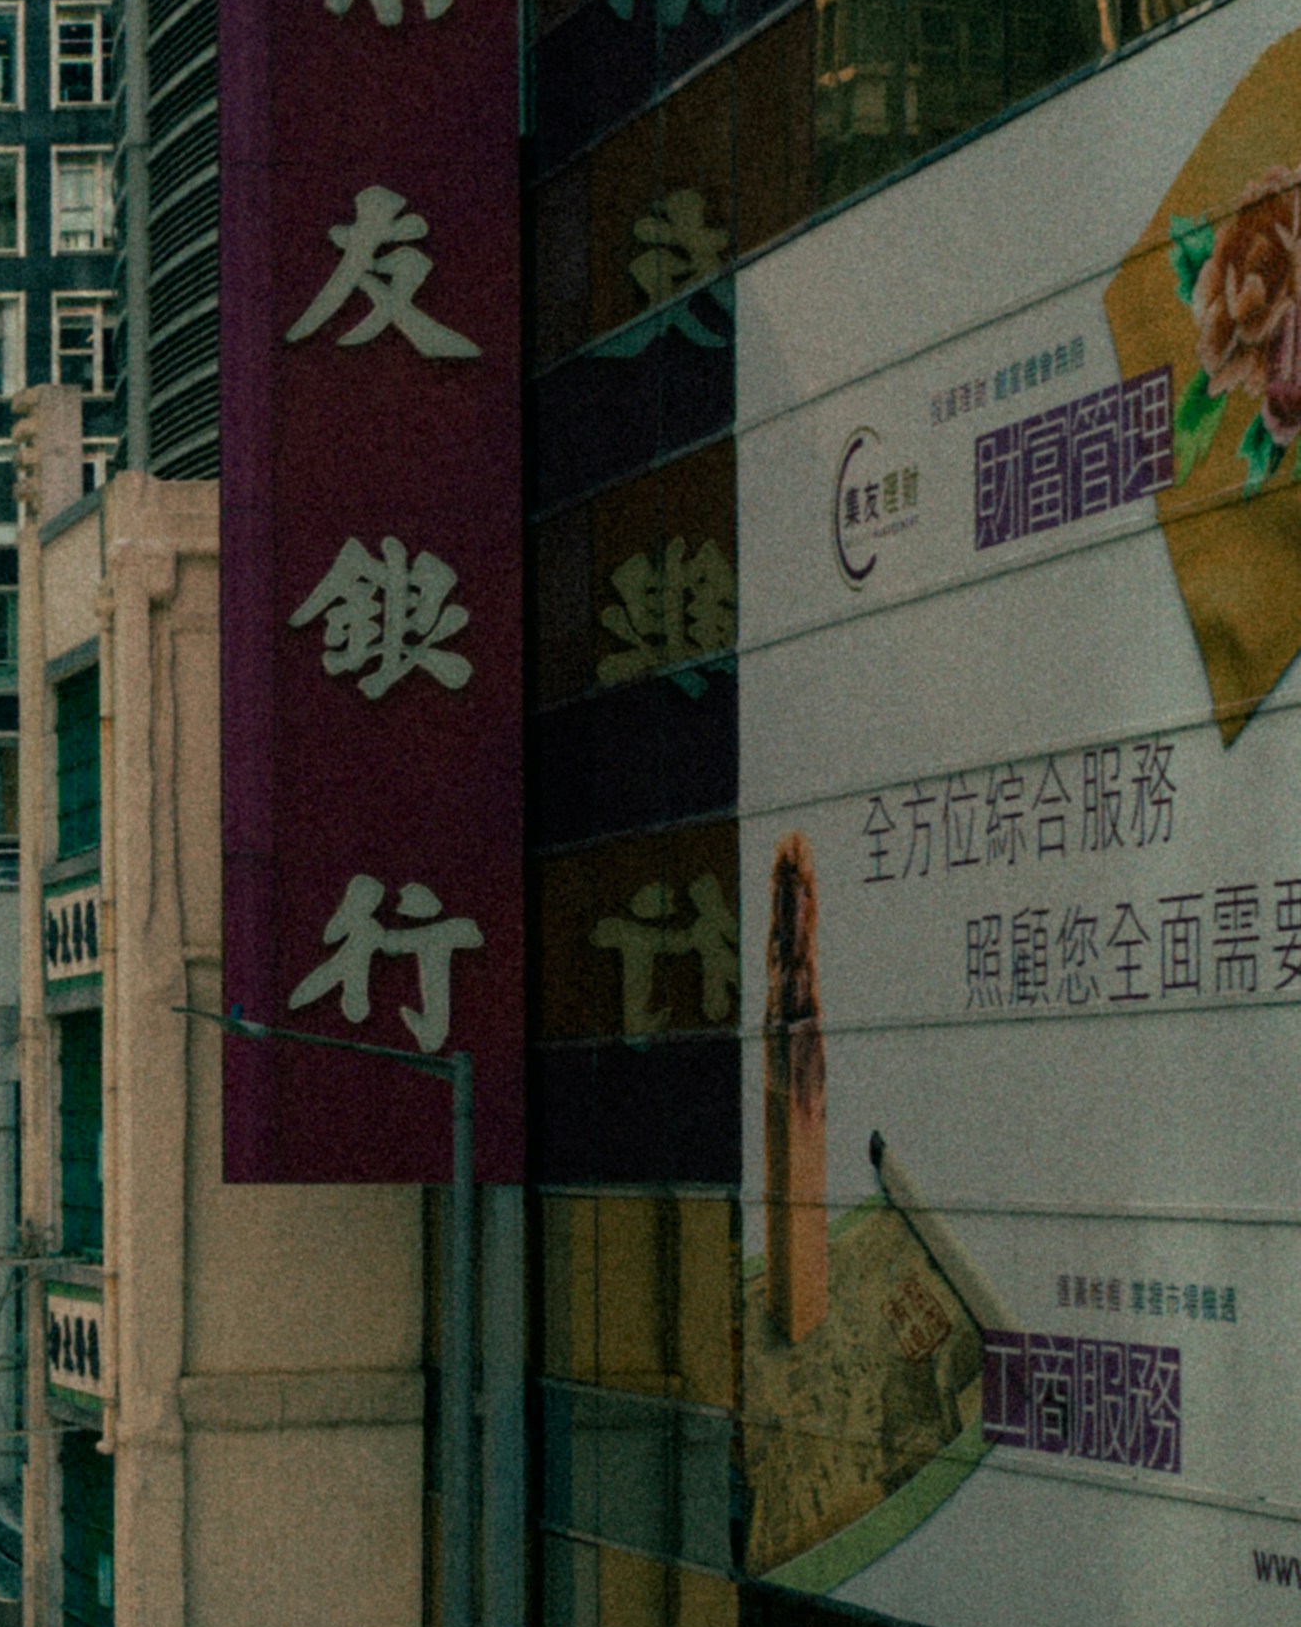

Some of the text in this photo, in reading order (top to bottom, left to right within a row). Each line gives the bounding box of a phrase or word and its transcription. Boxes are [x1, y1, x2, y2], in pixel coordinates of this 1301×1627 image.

[975, 369, 1175, 552] 財富管理
[861, 742, 1178, 885] 全方位綜合服務
[965, 877, 1301, 1010] 照顧您全面需要
[983, 1339, 1183, 1473] 工商服務
